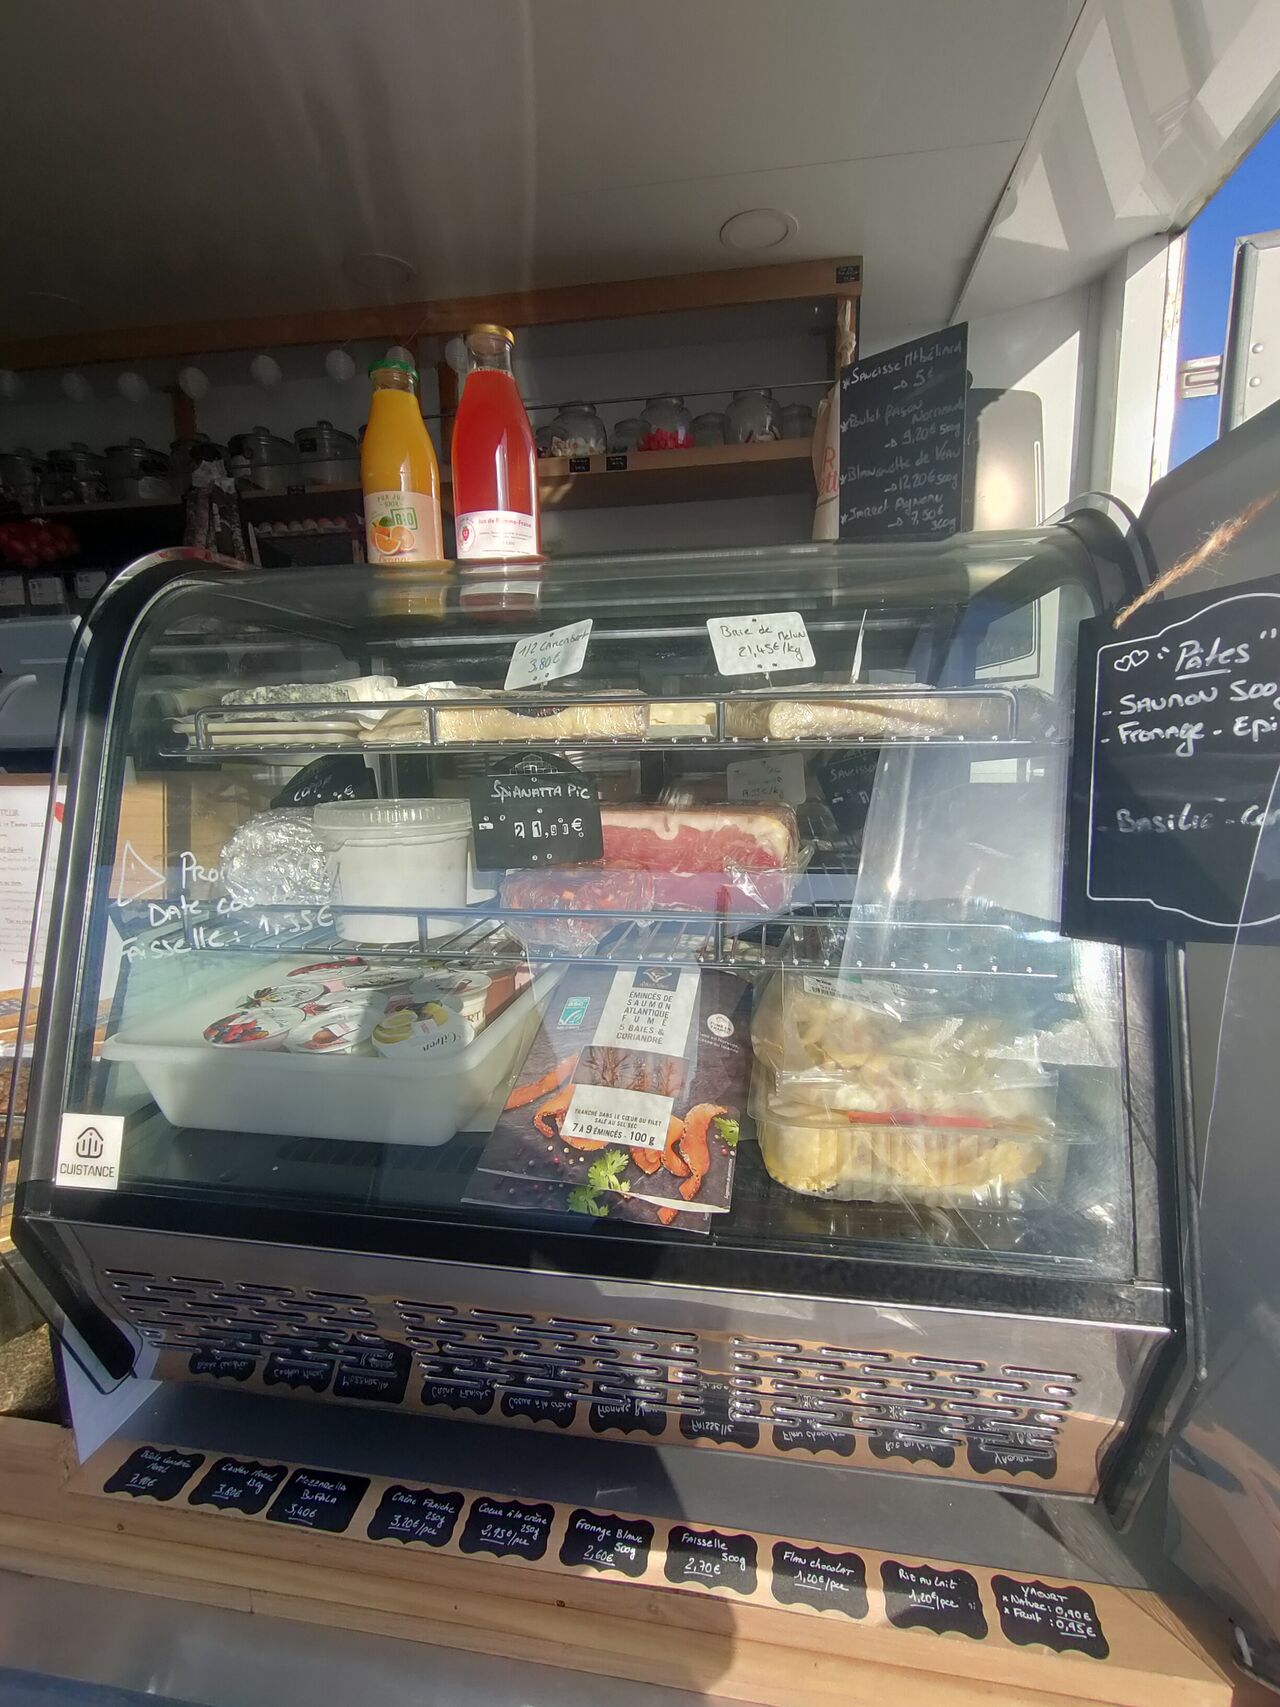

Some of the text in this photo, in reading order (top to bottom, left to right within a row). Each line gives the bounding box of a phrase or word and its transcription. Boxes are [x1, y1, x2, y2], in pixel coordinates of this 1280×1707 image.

[720, 625, 773, 638] Brie de
[148, 895, 202, 927] Date
[626, 999, 671, 1010] SAUMON
[663, 994, 673, 1003] DE
[624, 1007, 670, 1019] ATLANTIQUE
[619, 1023, 665, 1036] 5 BAIES &
[616, 1032, 663, 1045] CORIANDRE
[647, 1119, 662, 1127] FILET
[572, 1123, 579, 1132] 7
[585, 1124, 593, 1134] 9
[593, 1126, 622, 1139] ÉMINCÉS
[630, 1131, 648, 1143] 100
[648, 1136, 656, 1146] g
[60, 1163, 115, 1177] CUISTANCE
[575, 1518, 612, 1542] Fromage
[583, 1545, 614, 1563] 2,60€
[684, 1557, 722, 1575] 2,70€
[721, 1552, 746, 1571] 500g
